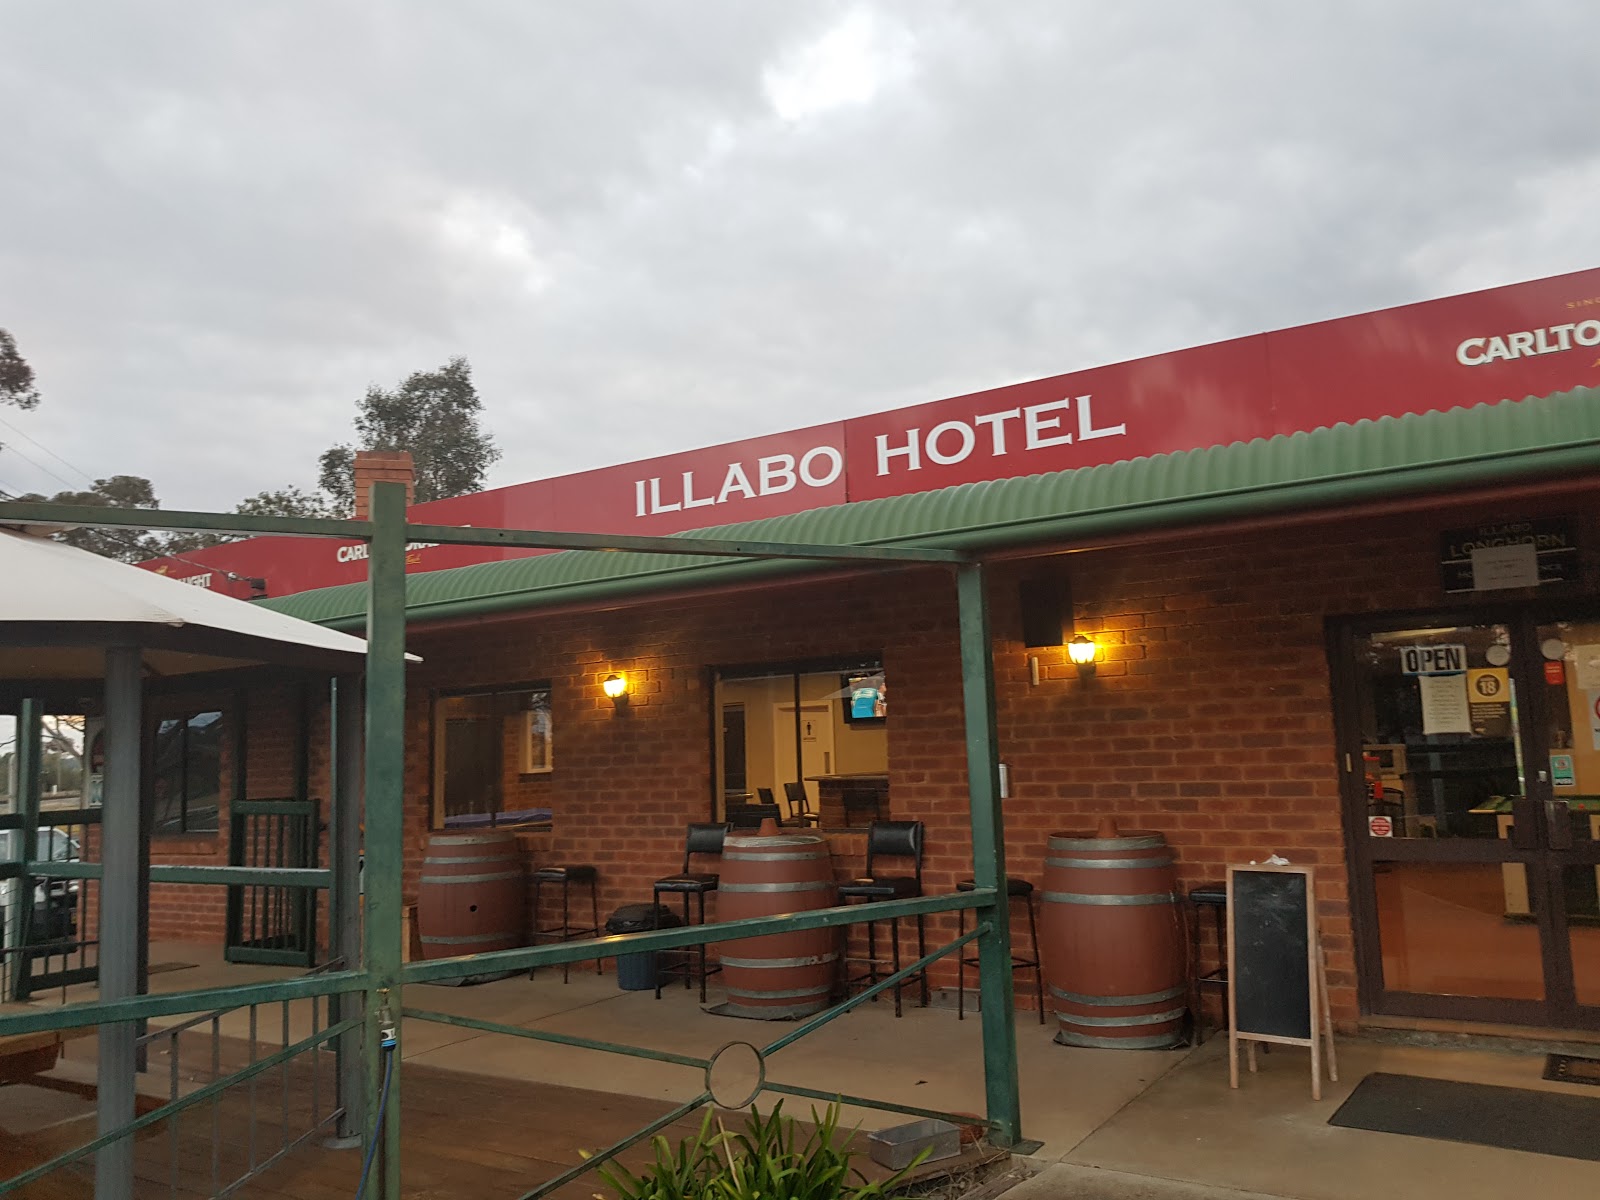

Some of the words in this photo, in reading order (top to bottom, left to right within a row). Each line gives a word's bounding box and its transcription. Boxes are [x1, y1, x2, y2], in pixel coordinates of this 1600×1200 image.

[1456, 319, 1600, 366] CARLTO
[634, 445, 844, 518] ILLABO
[874, 394, 1128, 477] HOTEL
[1405, 648, 1461, 672] OPEN
[1479, 681, 1497, 695] 18
